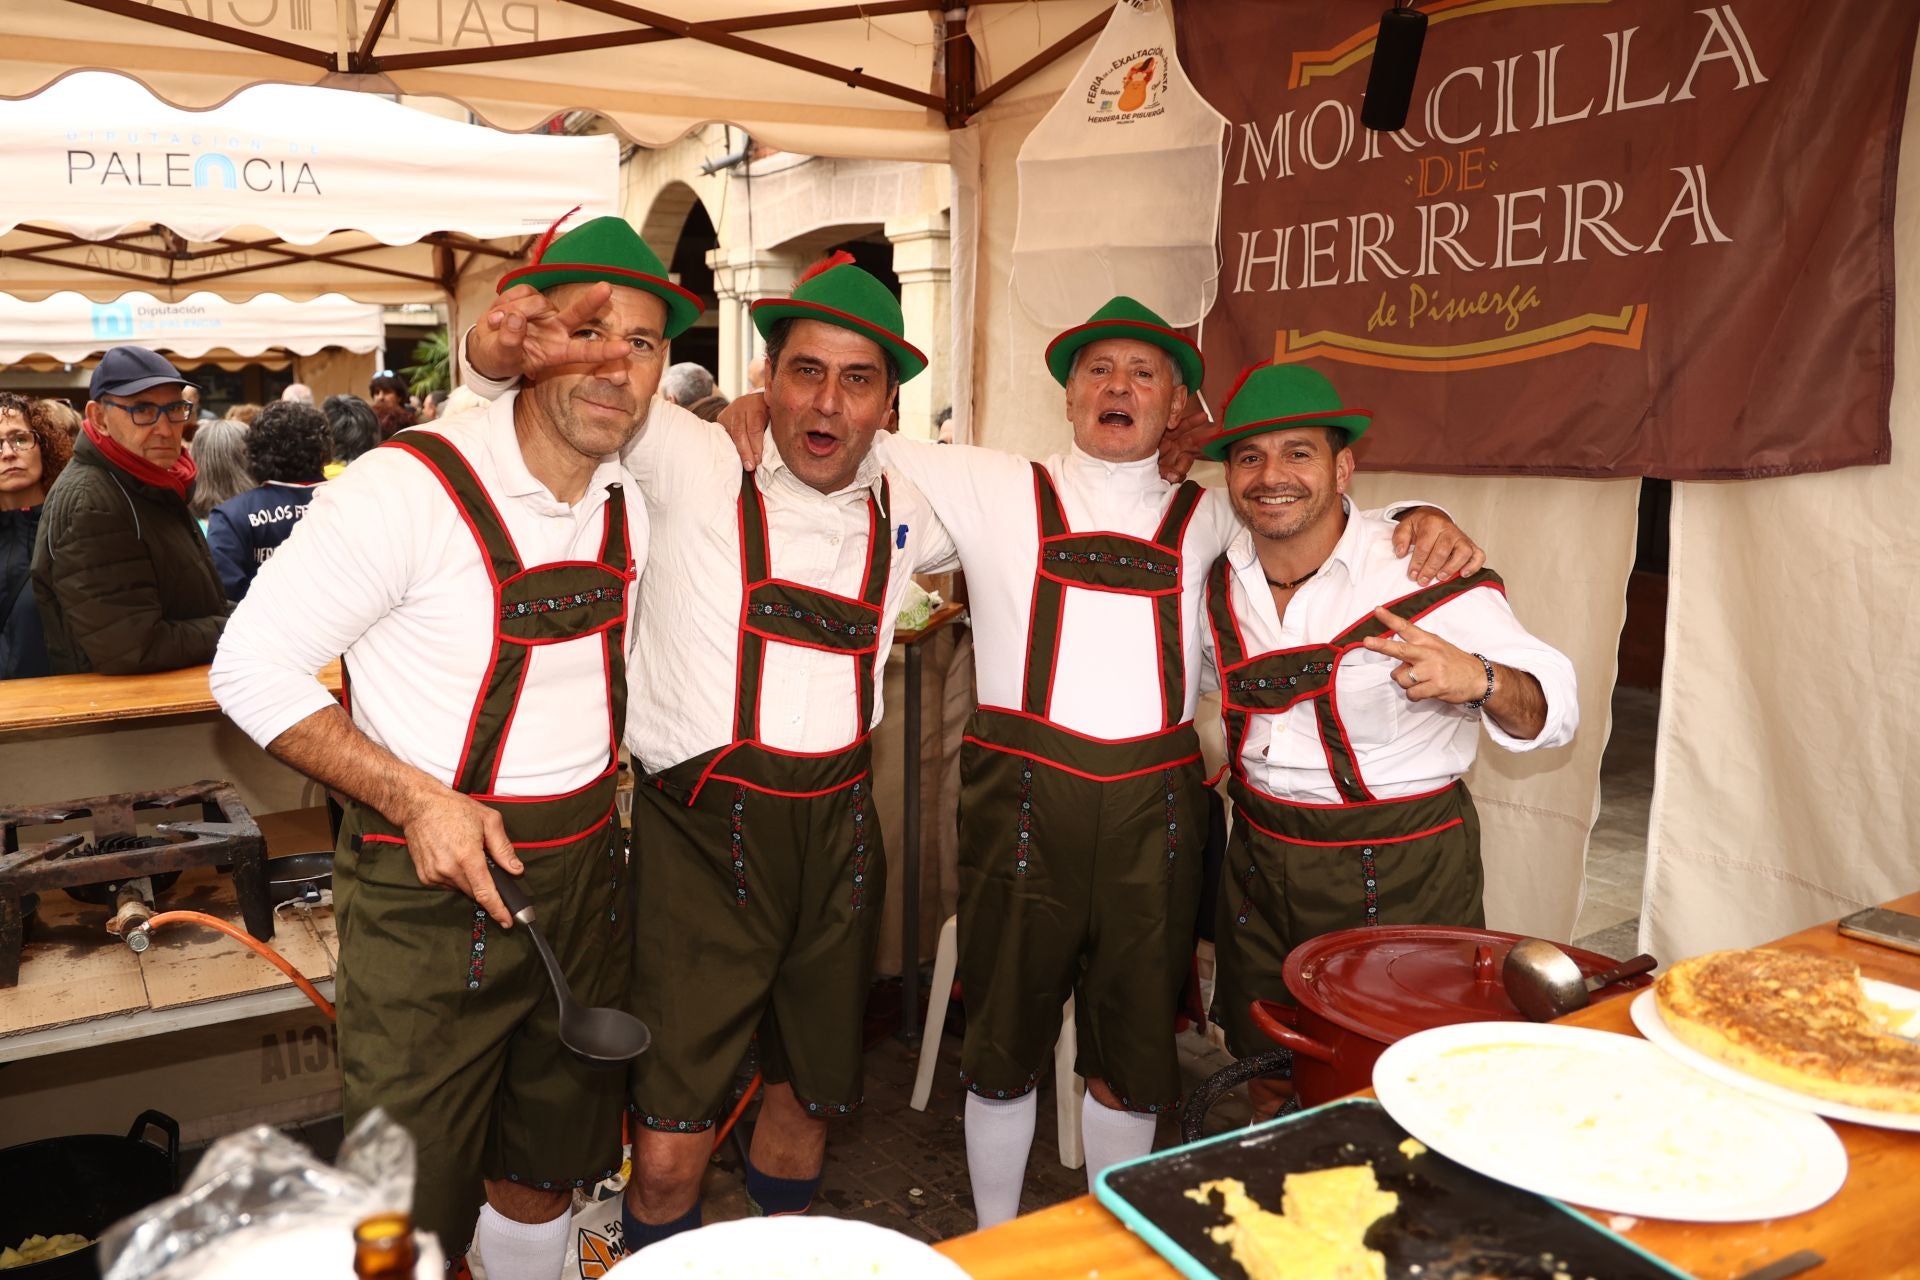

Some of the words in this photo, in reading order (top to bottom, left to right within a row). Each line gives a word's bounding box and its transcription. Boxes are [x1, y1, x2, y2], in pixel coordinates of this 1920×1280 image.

[1087, 76, 1104, 104] FERIA
[1088, 114, 1120, 123] HERRERA
[1132, 106, 1165, 119] PISUERGA
[1232, 164, 1733, 294] HERRERA
[137, 306, 206, 318] Diputación
[1367, 291, 1398, 332] de
[1409, 283, 1541, 331] Pisuerga
[248, 504, 293, 527] BOLOS
